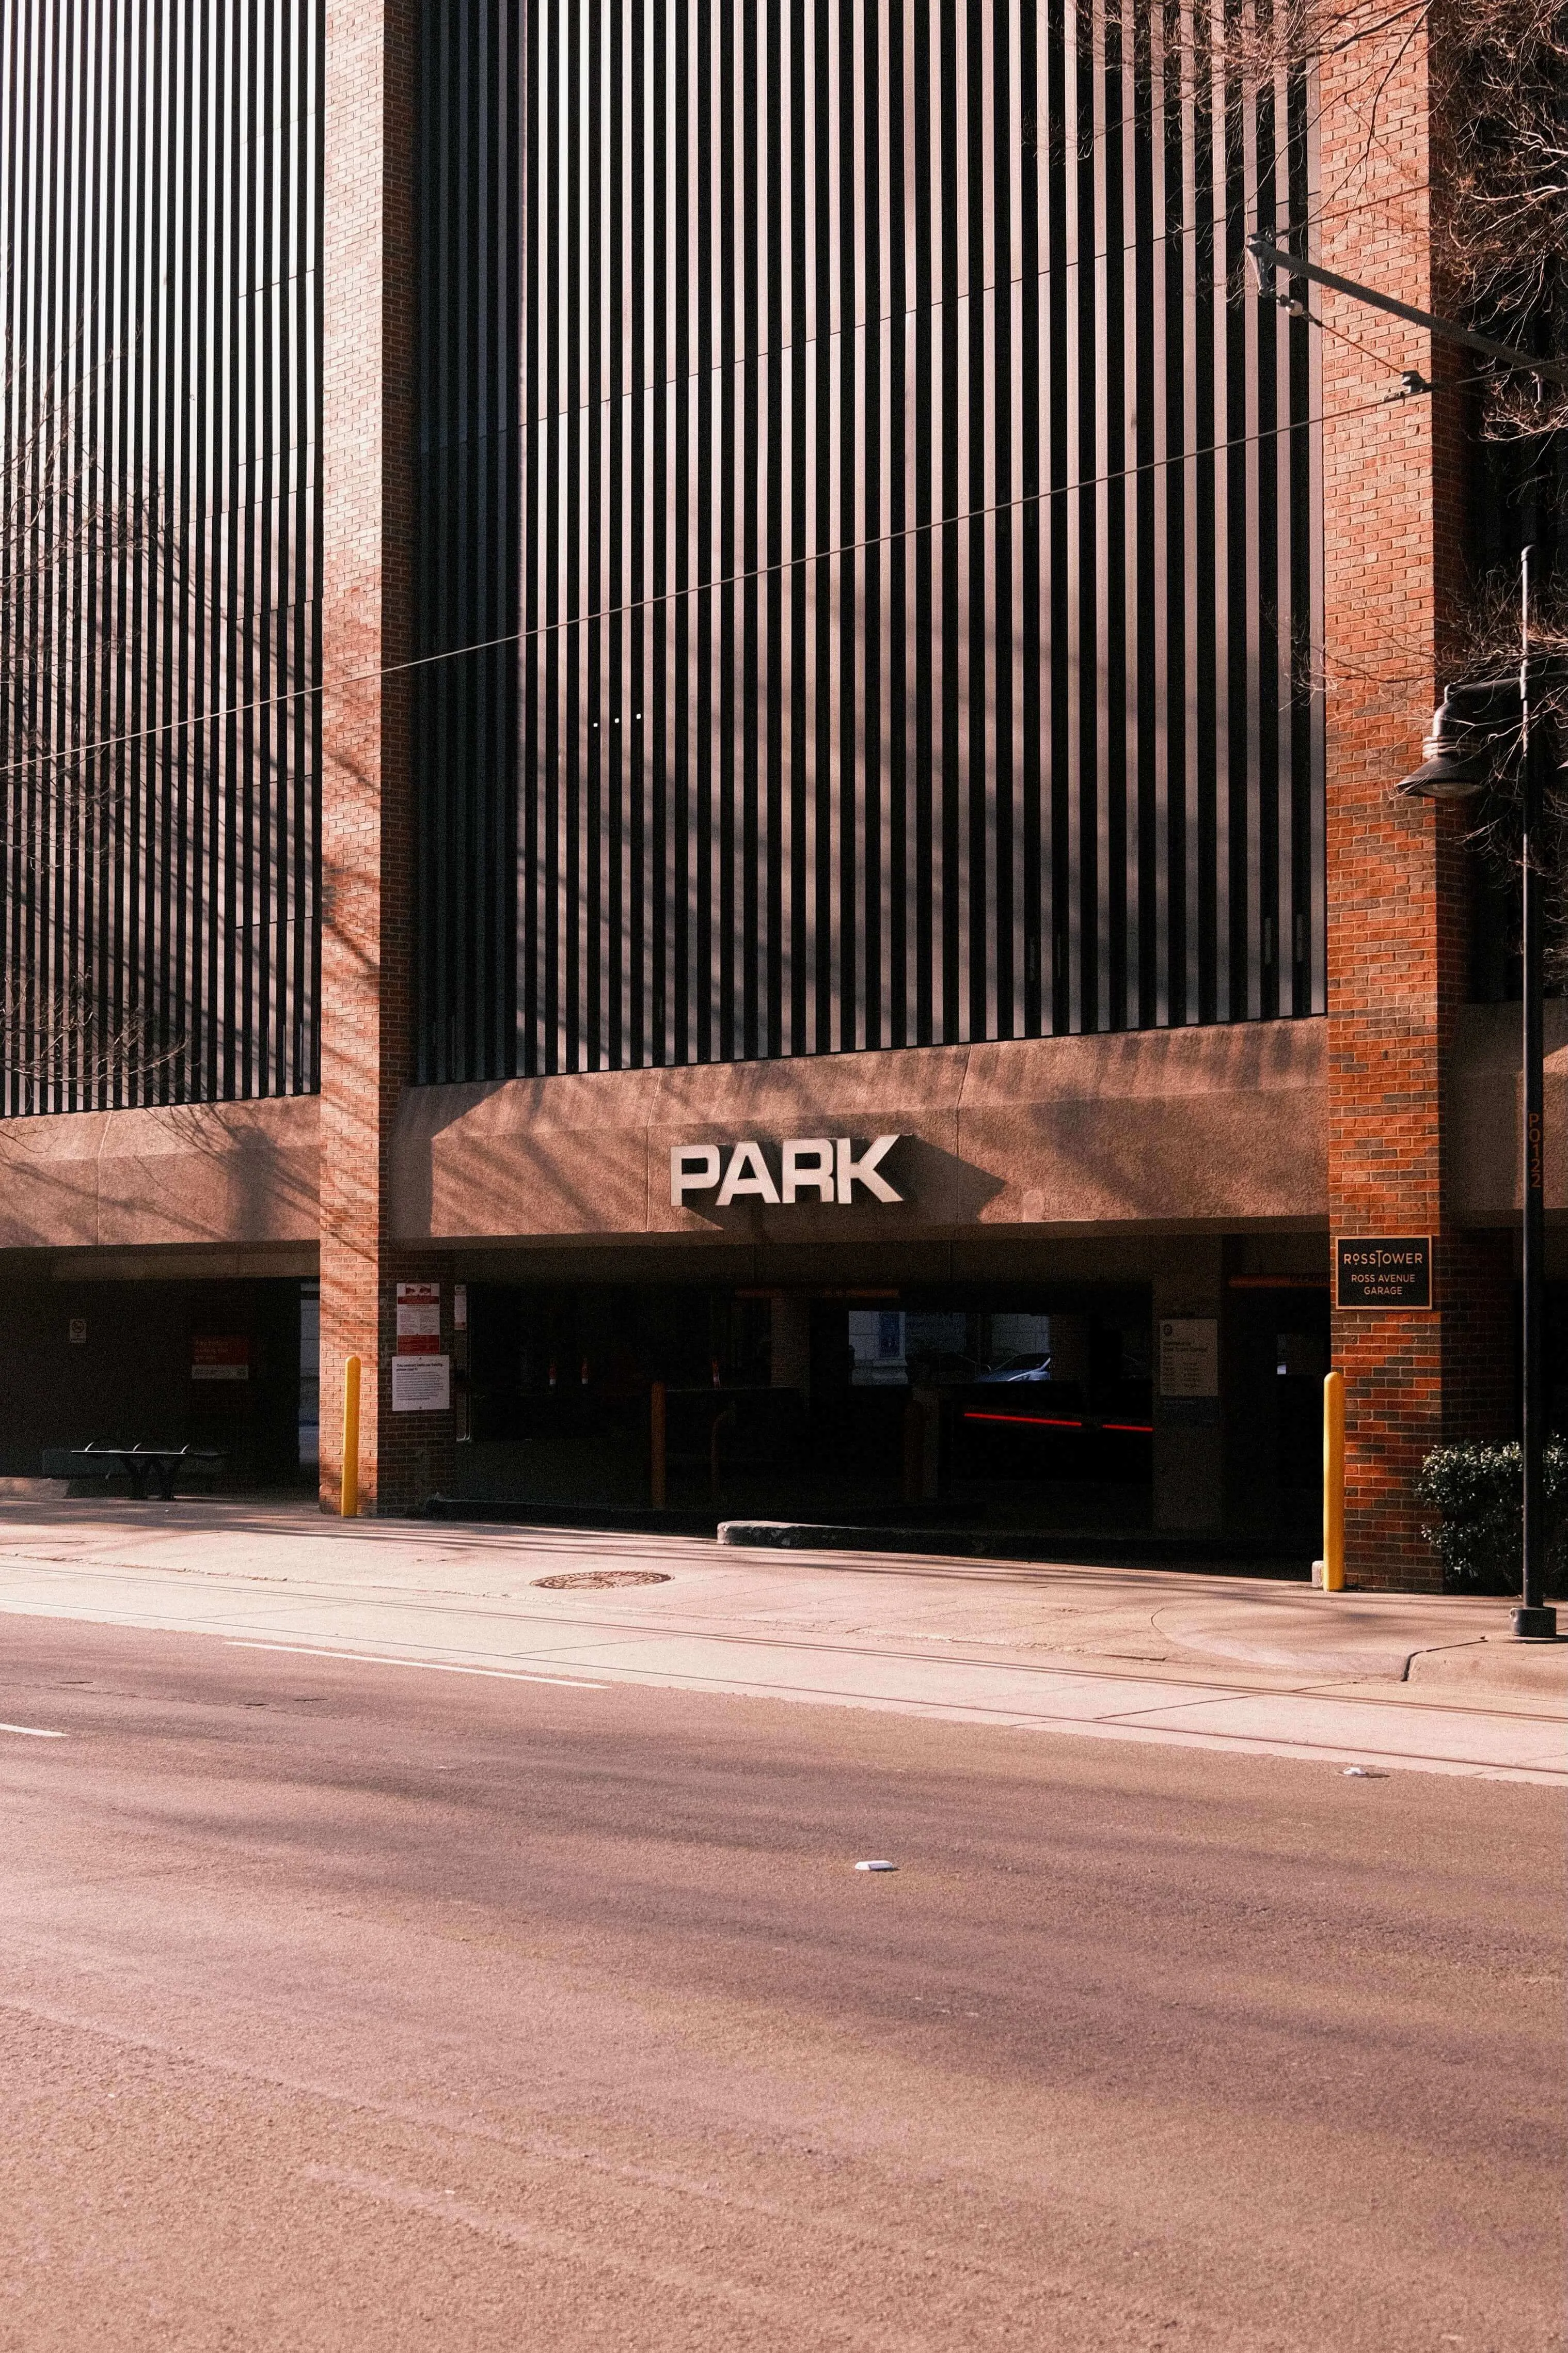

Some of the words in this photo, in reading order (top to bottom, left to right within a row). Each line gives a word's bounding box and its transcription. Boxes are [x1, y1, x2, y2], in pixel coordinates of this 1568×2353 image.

[671, 1134, 904, 1206] PARK
[1351, 1274, 1375, 1283] ROSS
[1378, 1274, 1415, 1282] AVENUE
[1364, 1287, 1403, 1295] GARAGE
